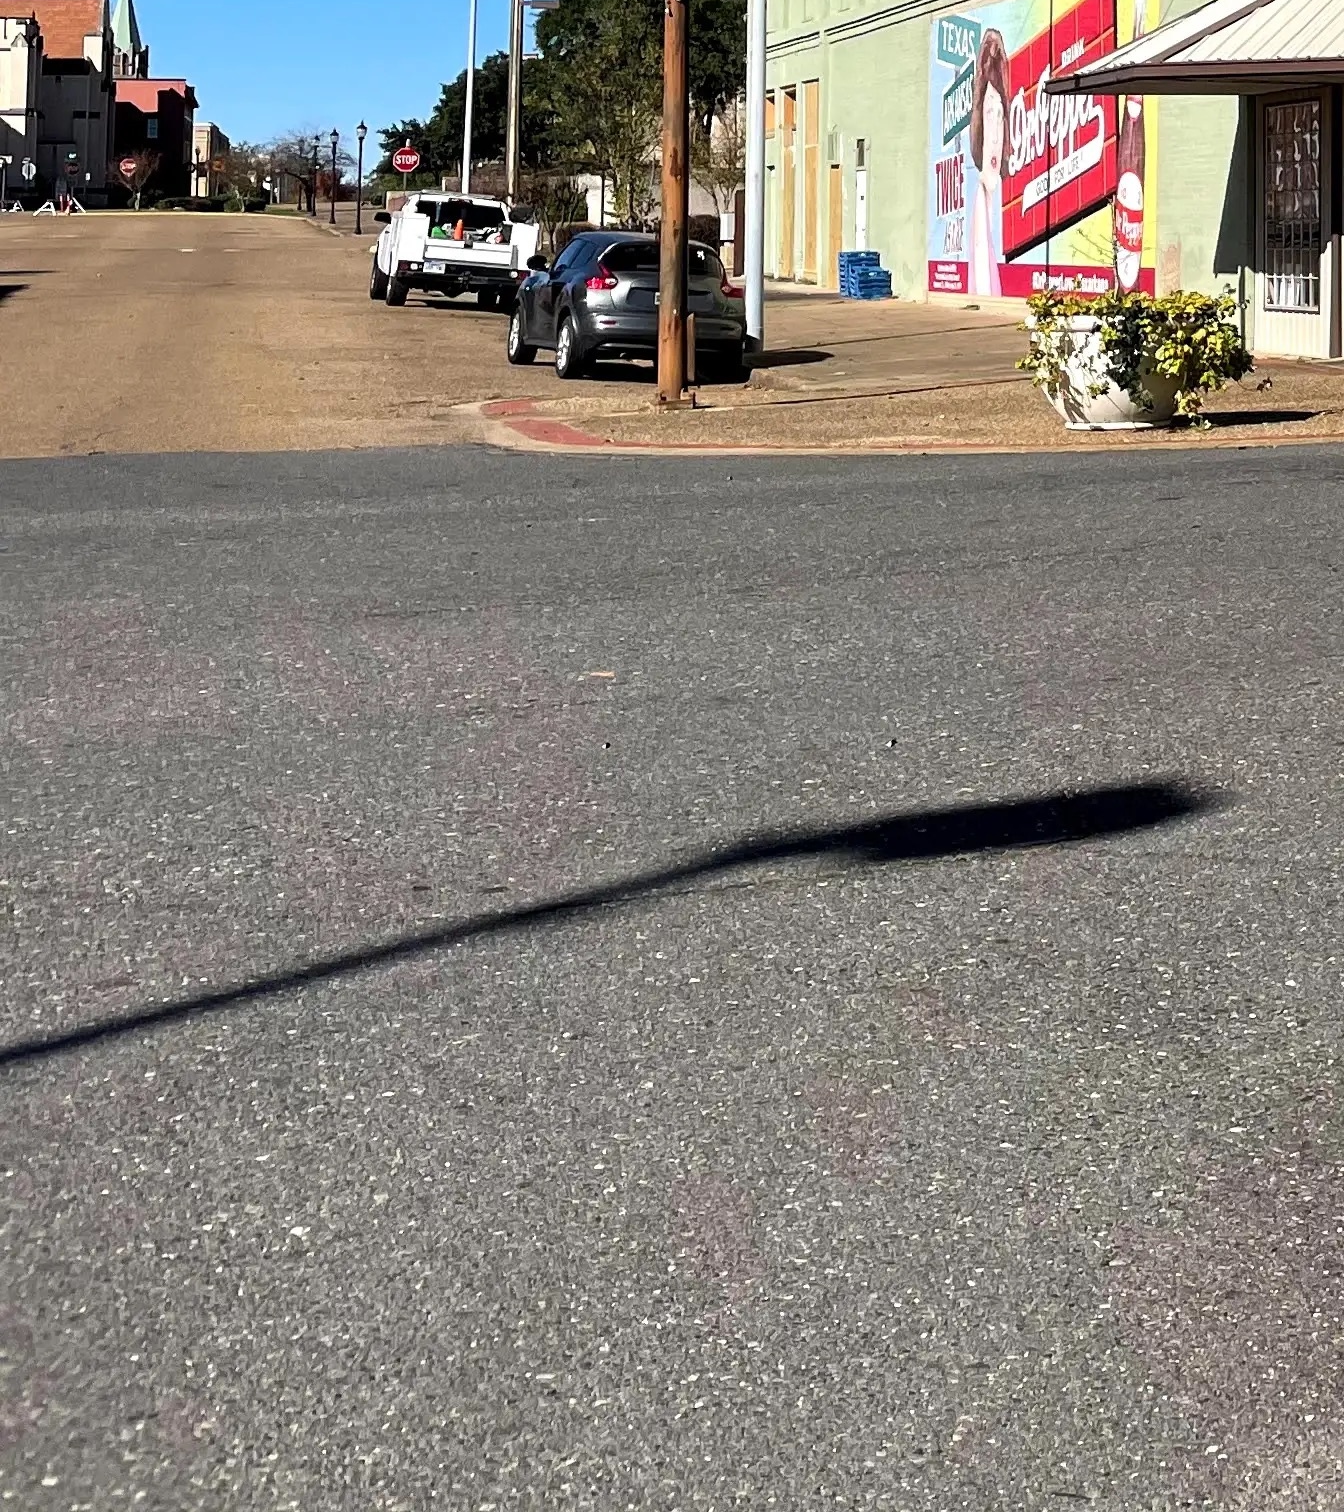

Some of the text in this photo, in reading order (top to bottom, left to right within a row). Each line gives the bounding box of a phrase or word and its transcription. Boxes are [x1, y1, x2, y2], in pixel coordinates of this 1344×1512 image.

[941, 20, 976, 59] TEXAS
[1061, 36, 1085, 69] DRINK
[395, 154, 418, 165] STOP
[935, 152, 965, 218] TWICE
